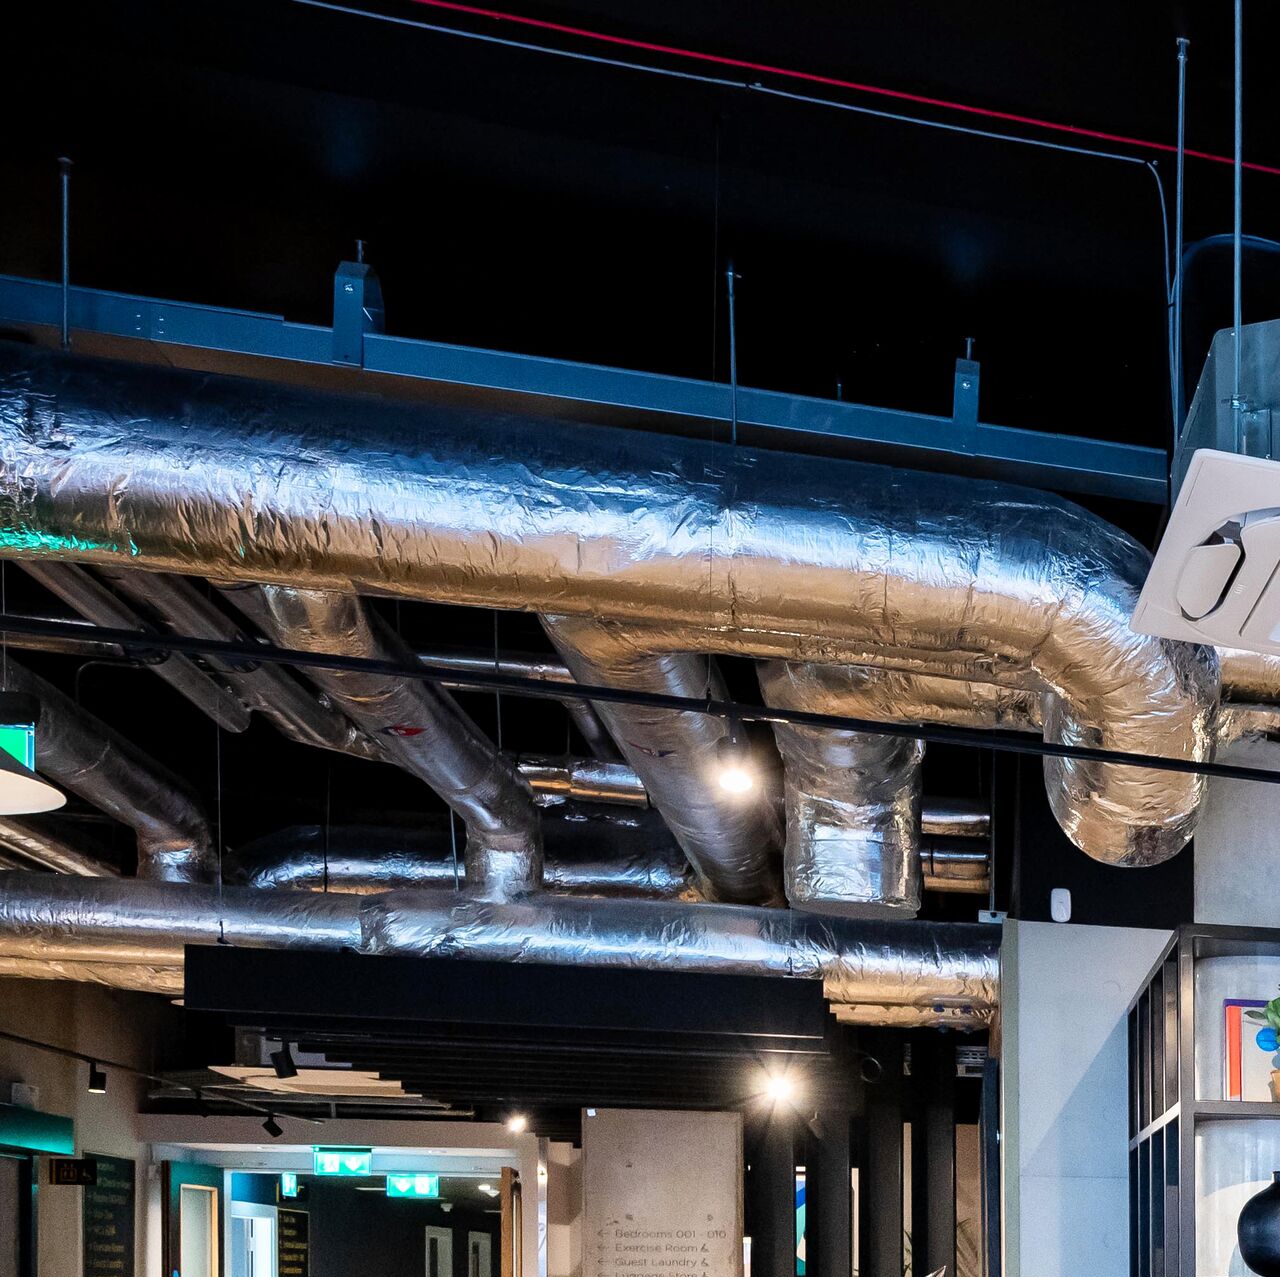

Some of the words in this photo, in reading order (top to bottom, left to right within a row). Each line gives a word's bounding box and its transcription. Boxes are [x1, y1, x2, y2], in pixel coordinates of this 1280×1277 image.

[615, 1229, 673, 1239] Bedrooms
[675, 1230, 696, 1239] 001
[707, 1230, 727, 1239] 010
[615, 1243, 662, 1252] Exercise
[665, 1244, 698, 1252] Room
[615, 1258, 647, 1267] Guest
[651, 1258, 698, 1268] Laundry
